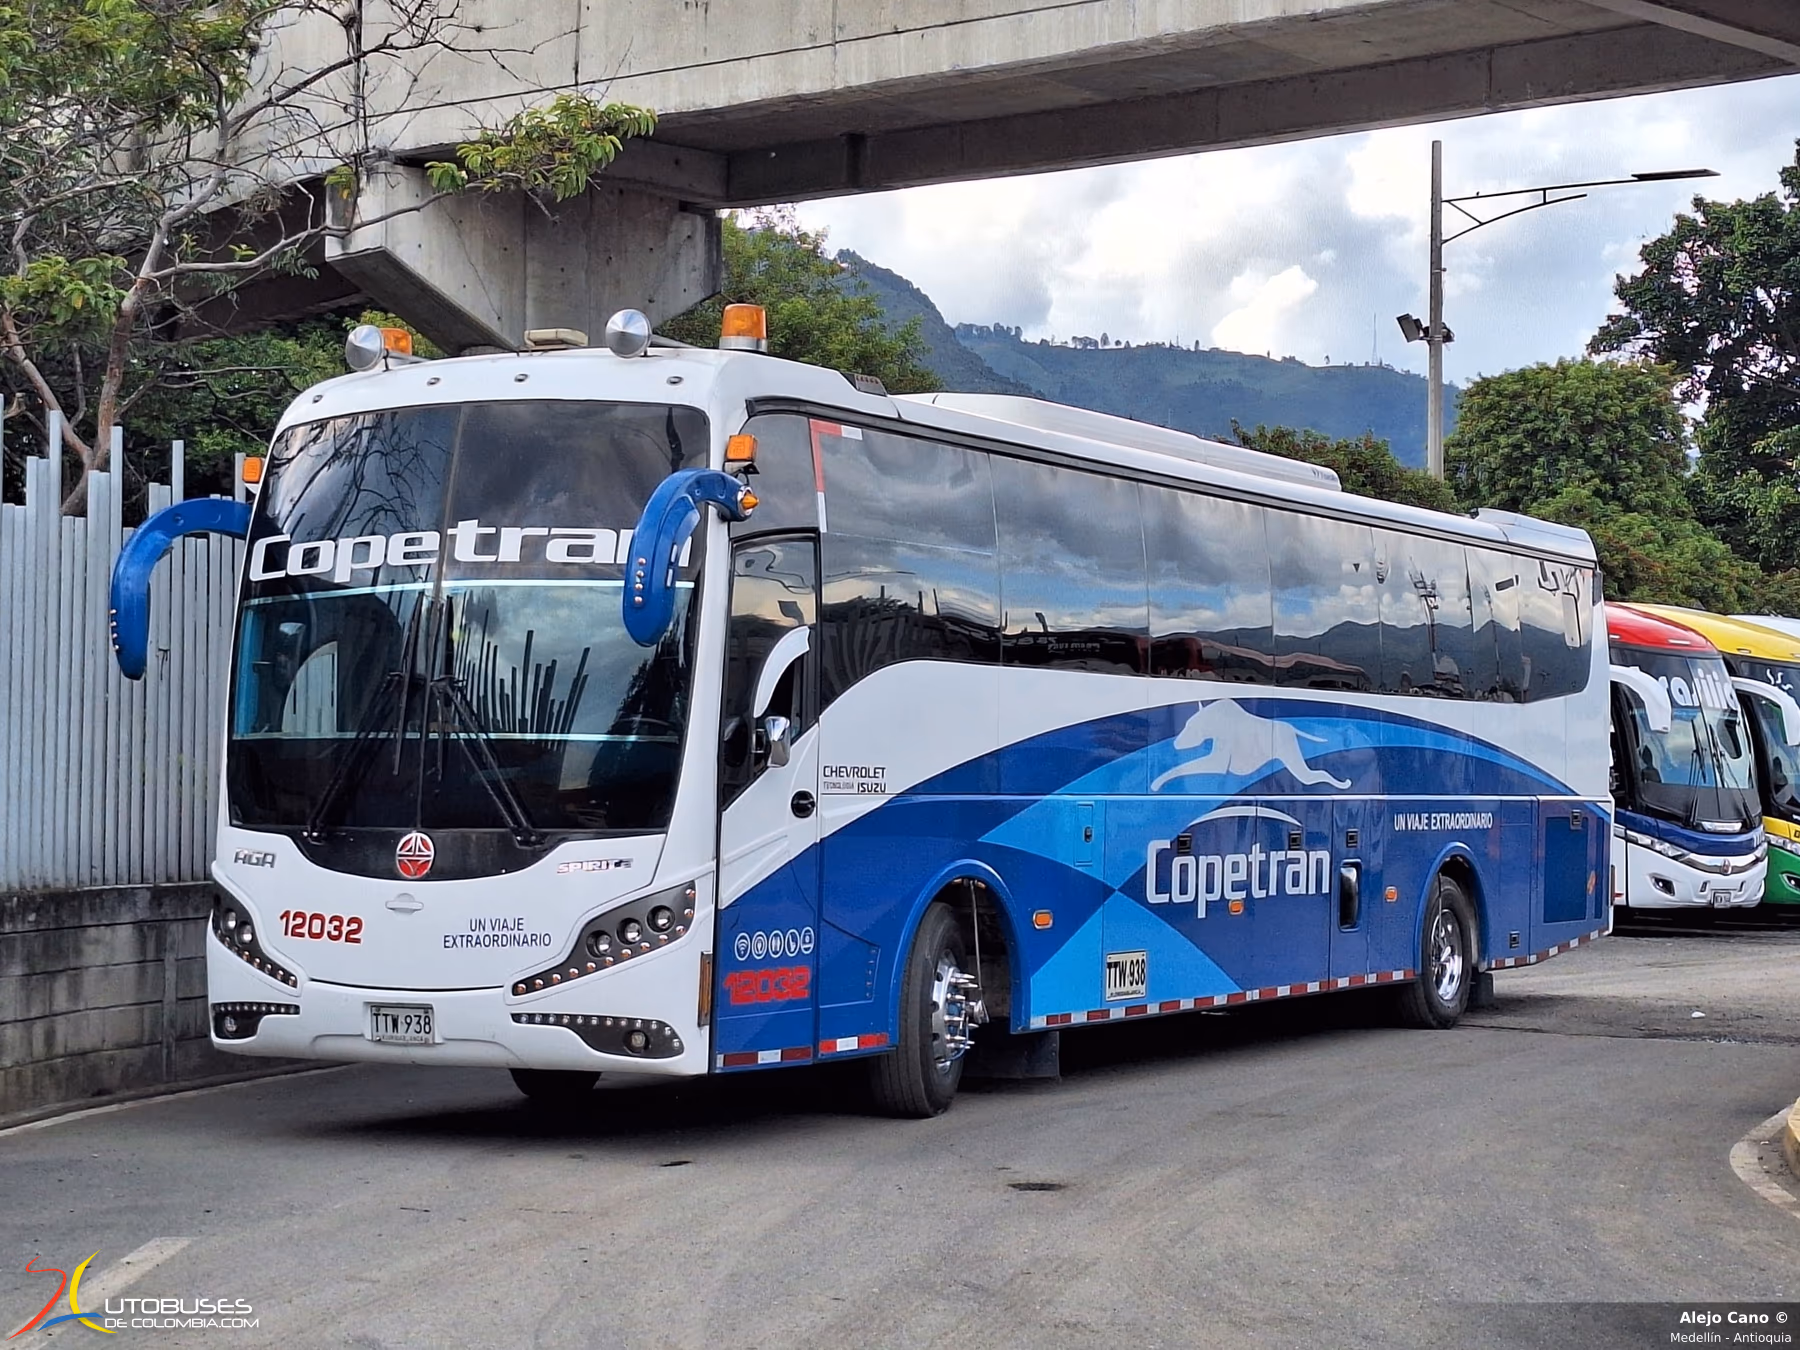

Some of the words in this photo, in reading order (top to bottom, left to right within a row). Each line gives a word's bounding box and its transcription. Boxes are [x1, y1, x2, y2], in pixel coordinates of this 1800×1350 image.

[823, 765, 886, 779] CHEVROLET
[857, 782, 887, 793] ISUZU
[1394, 813, 1405, 831] UN
[1407, 813, 1429, 830] VIAJE
[1431, 812, 1493, 830] EXTRAORDINARIO
[1146, 839, 1331, 918] Copetran
[279, 910, 363, 944] 12032
[469, 918, 486, 932] UN
[489, 917, 524, 932] VIAJE
[443, 932, 552, 949] EXTRAORDINARIO
[1129, 958, 1146, 987] 938
[724, 966, 809, 1004] 12032
[373, 1012, 399, 1034] TTW
[404, 1014, 432, 1035] 938
